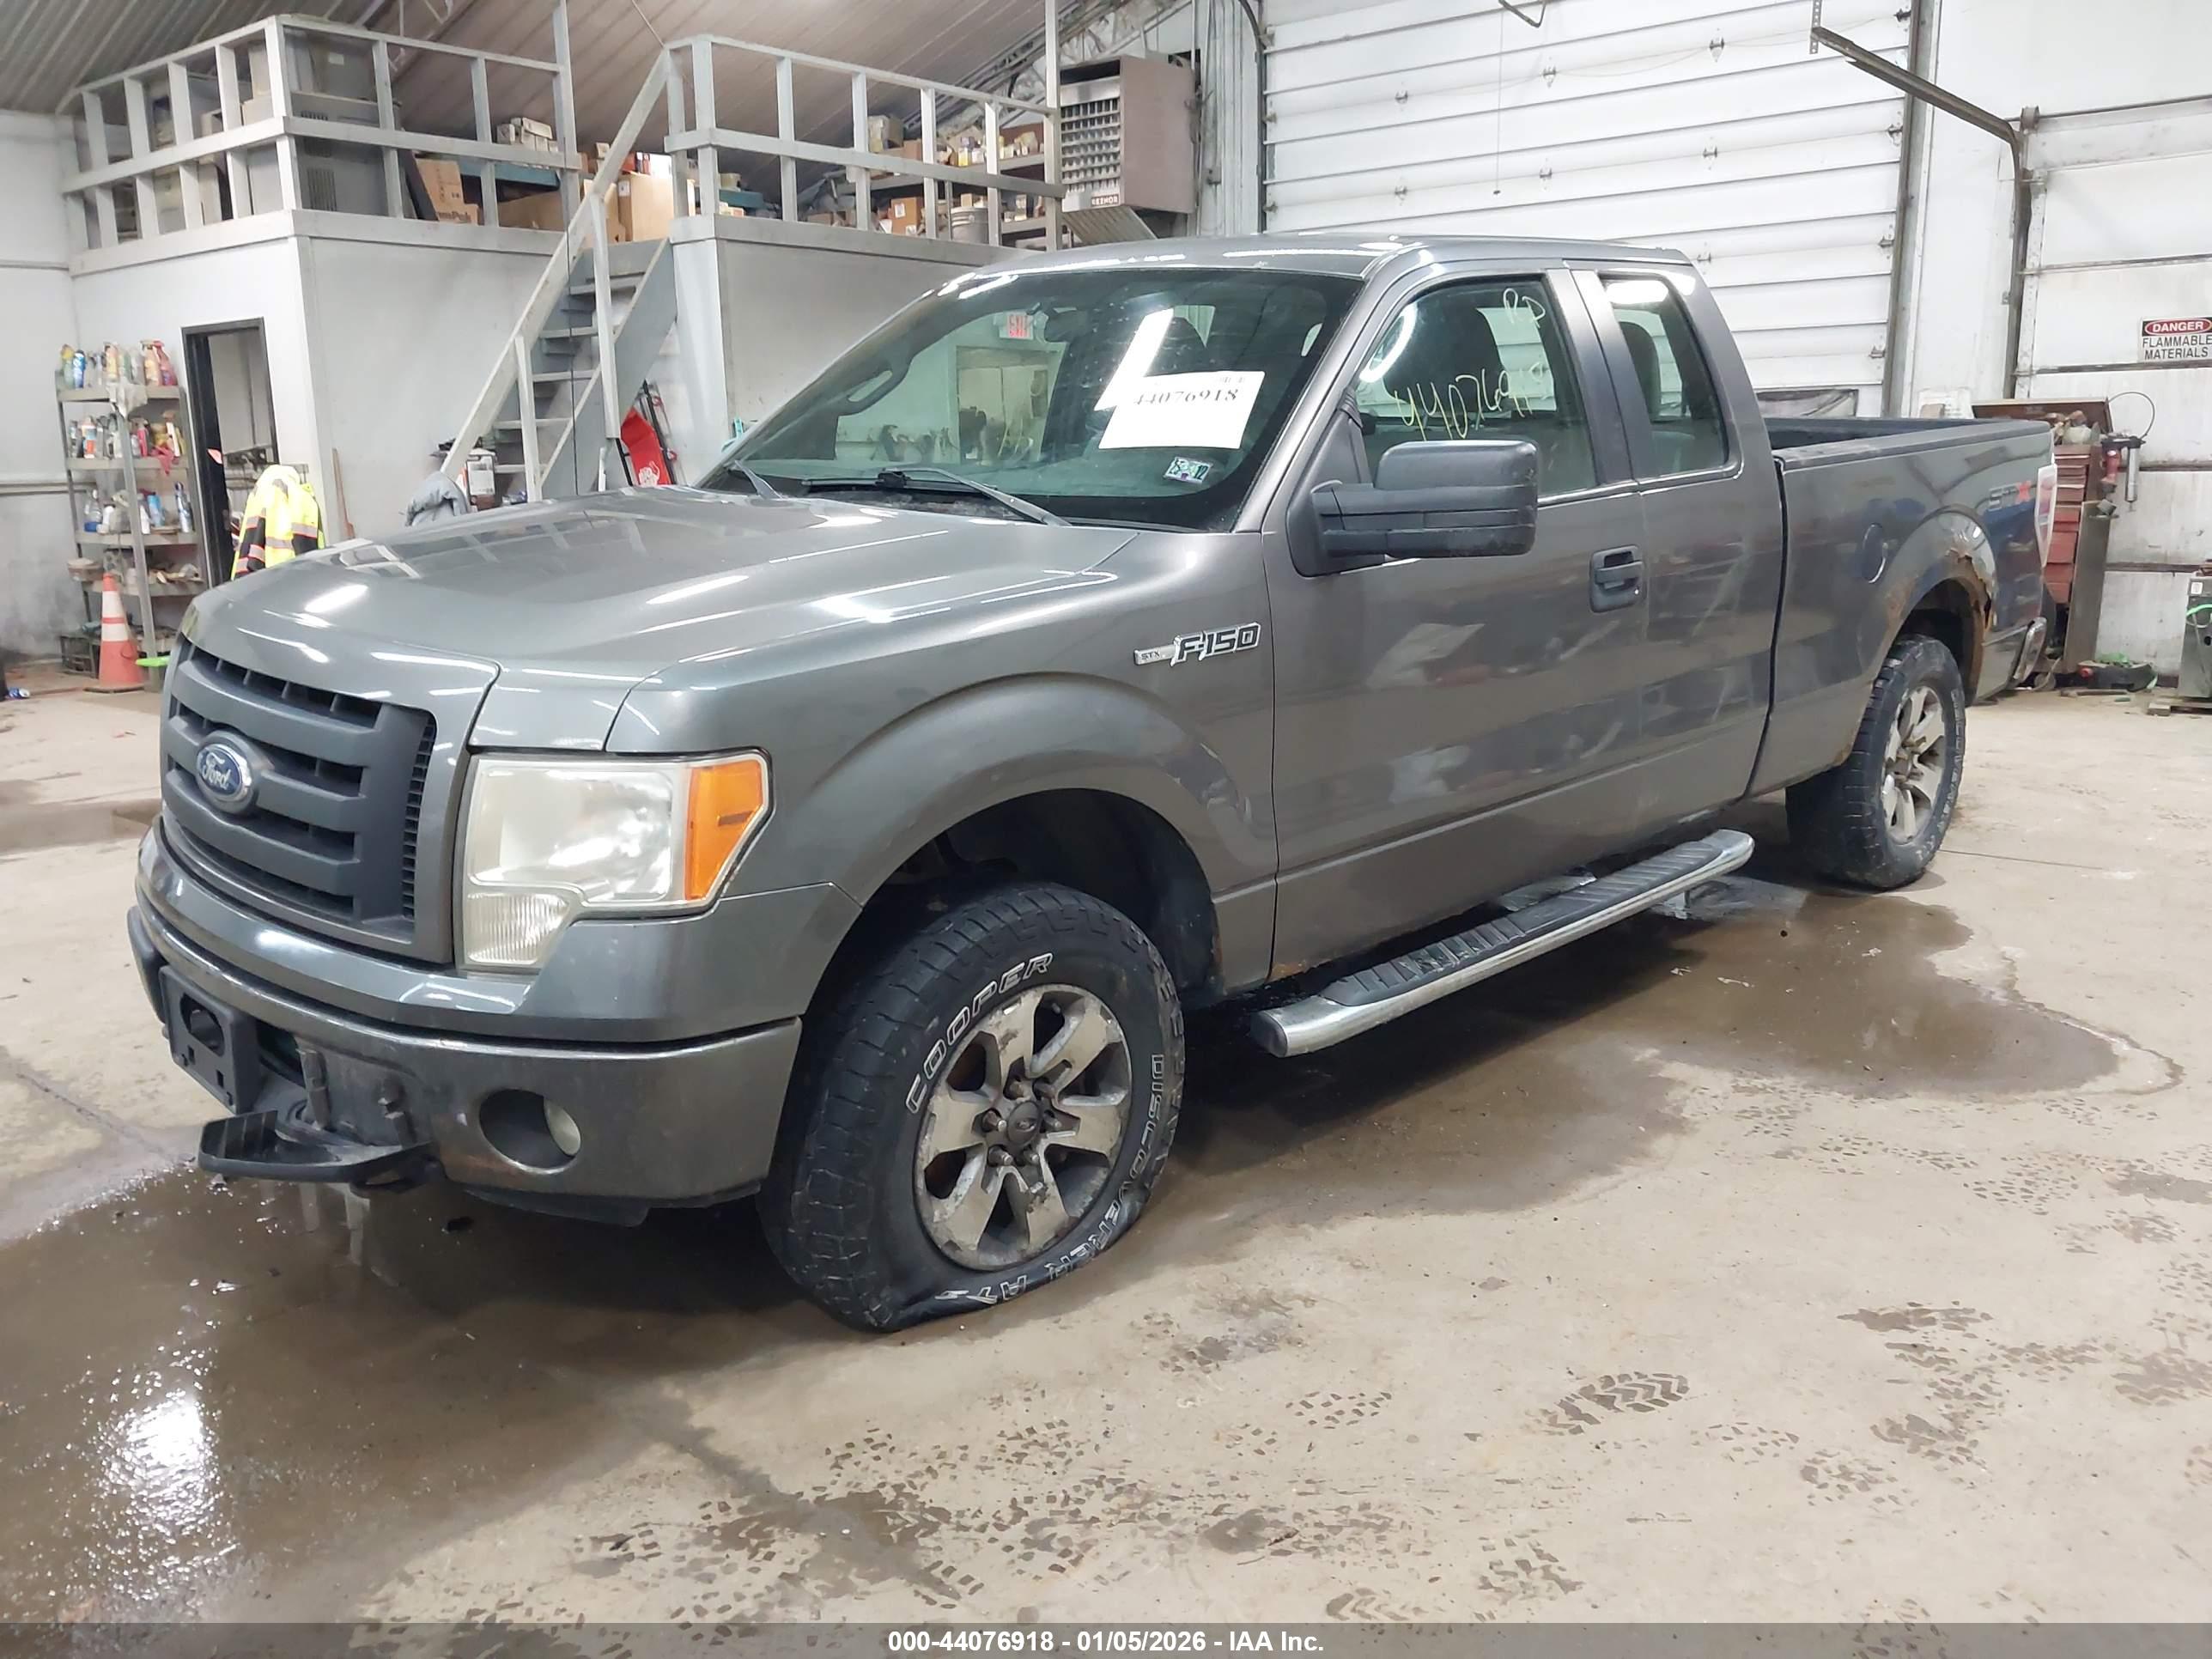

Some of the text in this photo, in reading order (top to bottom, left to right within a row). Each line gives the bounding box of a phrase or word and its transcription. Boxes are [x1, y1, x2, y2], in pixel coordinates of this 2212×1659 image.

[2152, 321, 2204, 332] DANGER
[2142, 334, 2212, 348] FLAMMABLE
[2144, 347, 2209, 360] MATERIALS
[1141, 621, 1261, 667] STX F-150
[201, 751, 231, 791] Ford
[906, 952, 1054, 1115] COOPER
